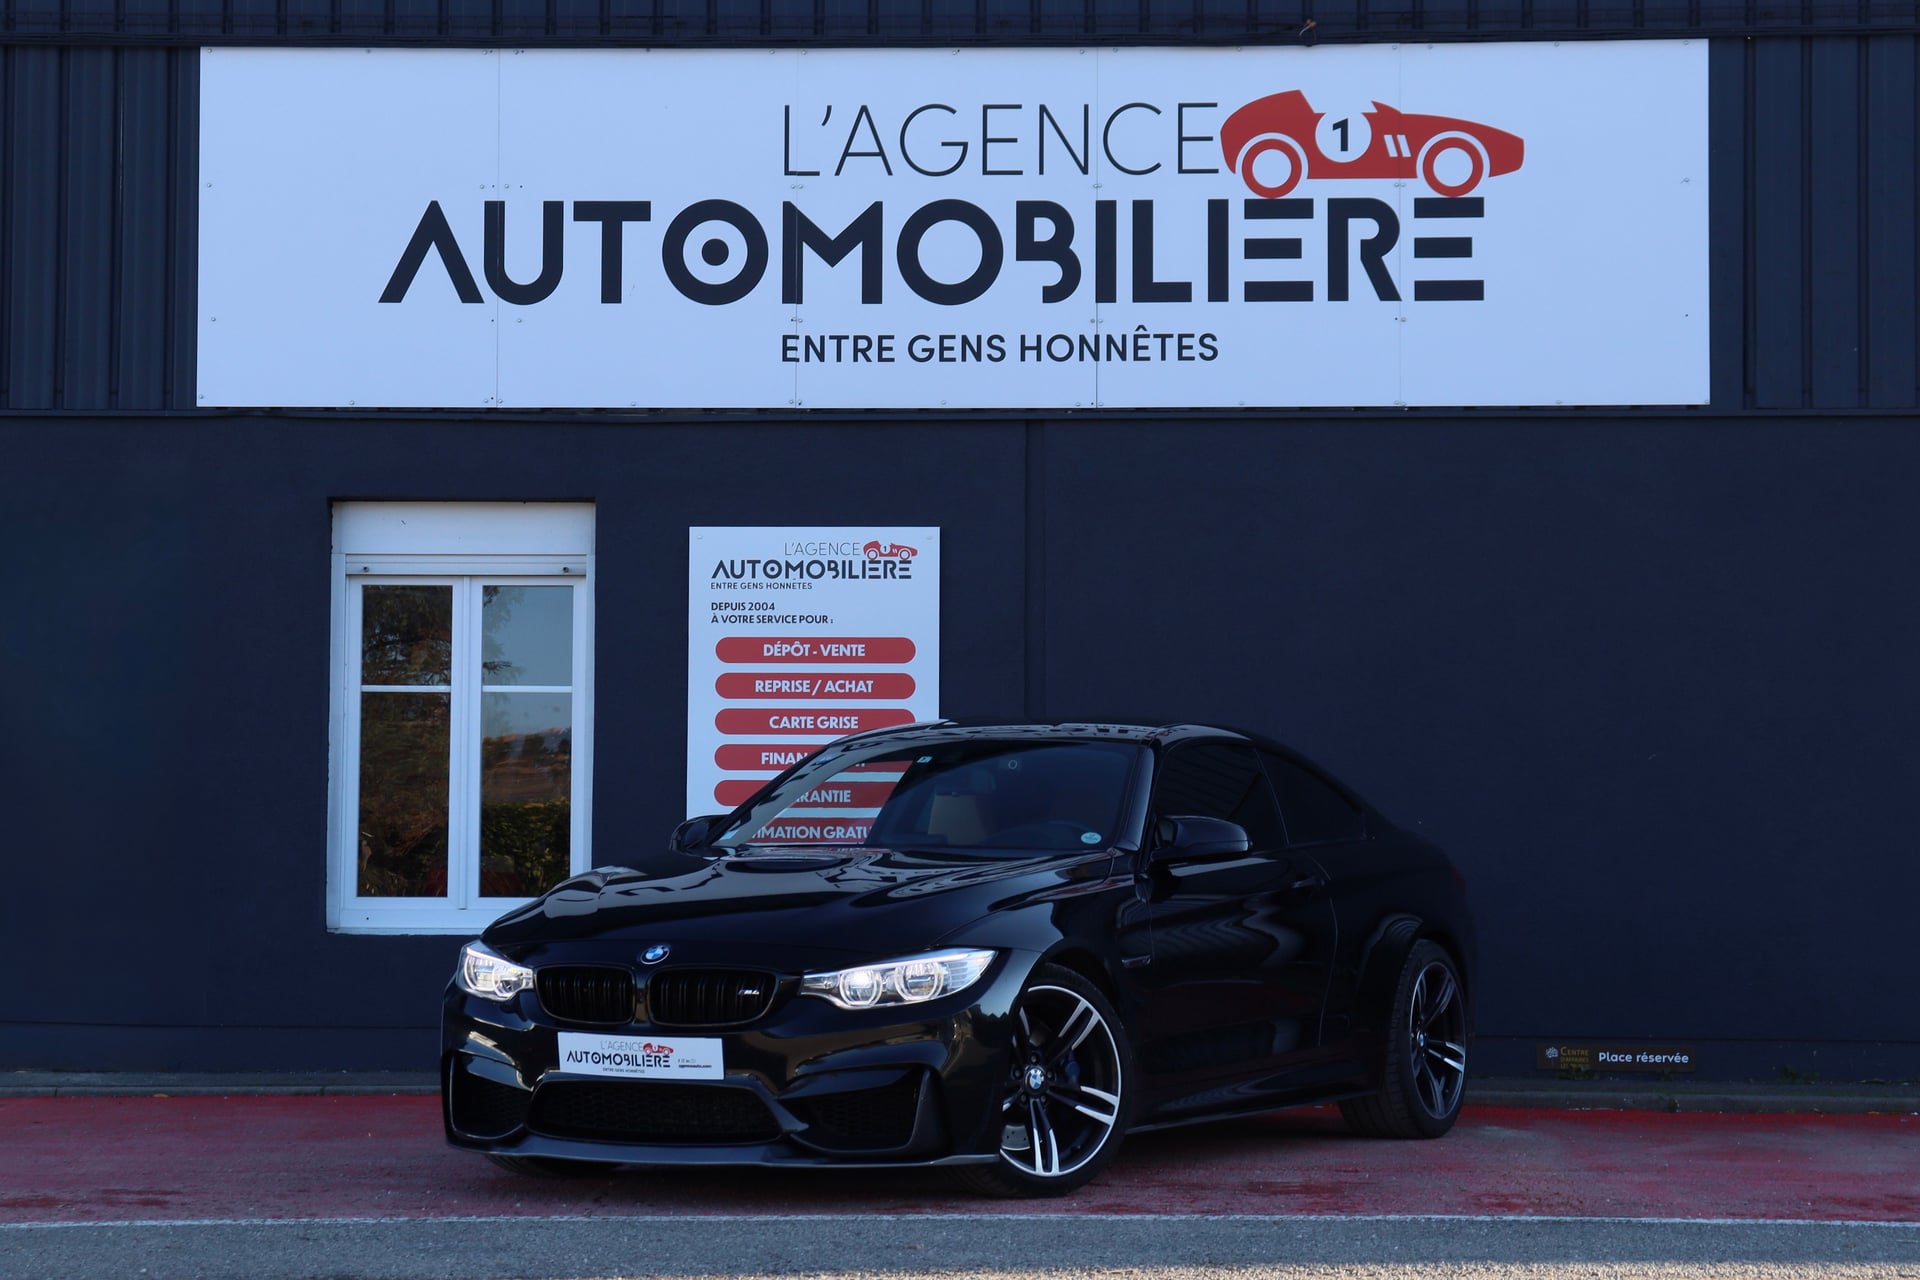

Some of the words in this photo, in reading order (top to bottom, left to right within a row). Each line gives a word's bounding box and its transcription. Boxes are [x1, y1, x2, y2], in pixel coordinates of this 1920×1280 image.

[784, 102, 1220, 177] L'AGENCE
[1332, 117, 1350, 152] 1
[782, 335, 895, 363] ENTRE
[907, 334, 1007, 363] GENS
[1020, 324, 1219, 363] HONNÊTES
[784, 542, 861, 556] L'AGENCE
[711, 582, 738, 590] ENTRE
[740, 582, 764, 590] GENS
[711, 602, 746, 612] DEPUIS
[748, 602, 775, 612] 2004
[711, 612, 719, 624] À
[721, 615, 755, 624] VOTRE
[757, 615, 797, 624] SERVICE
[799, 615, 828, 624] POUR
[763, 641, 810, 656] DÉPÔT
[820, 644, 866, 657] VENTE
[755, 680, 810, 693] REPRISE
[824, 680, 874, 693] ACHAT
[769, 716, 814, 729] CARTE
[817, 716, 859, 729] GRISE
[1598, 1052, 1633, 1063] Place
[1636, 1052, 1690, 1064] réservée
